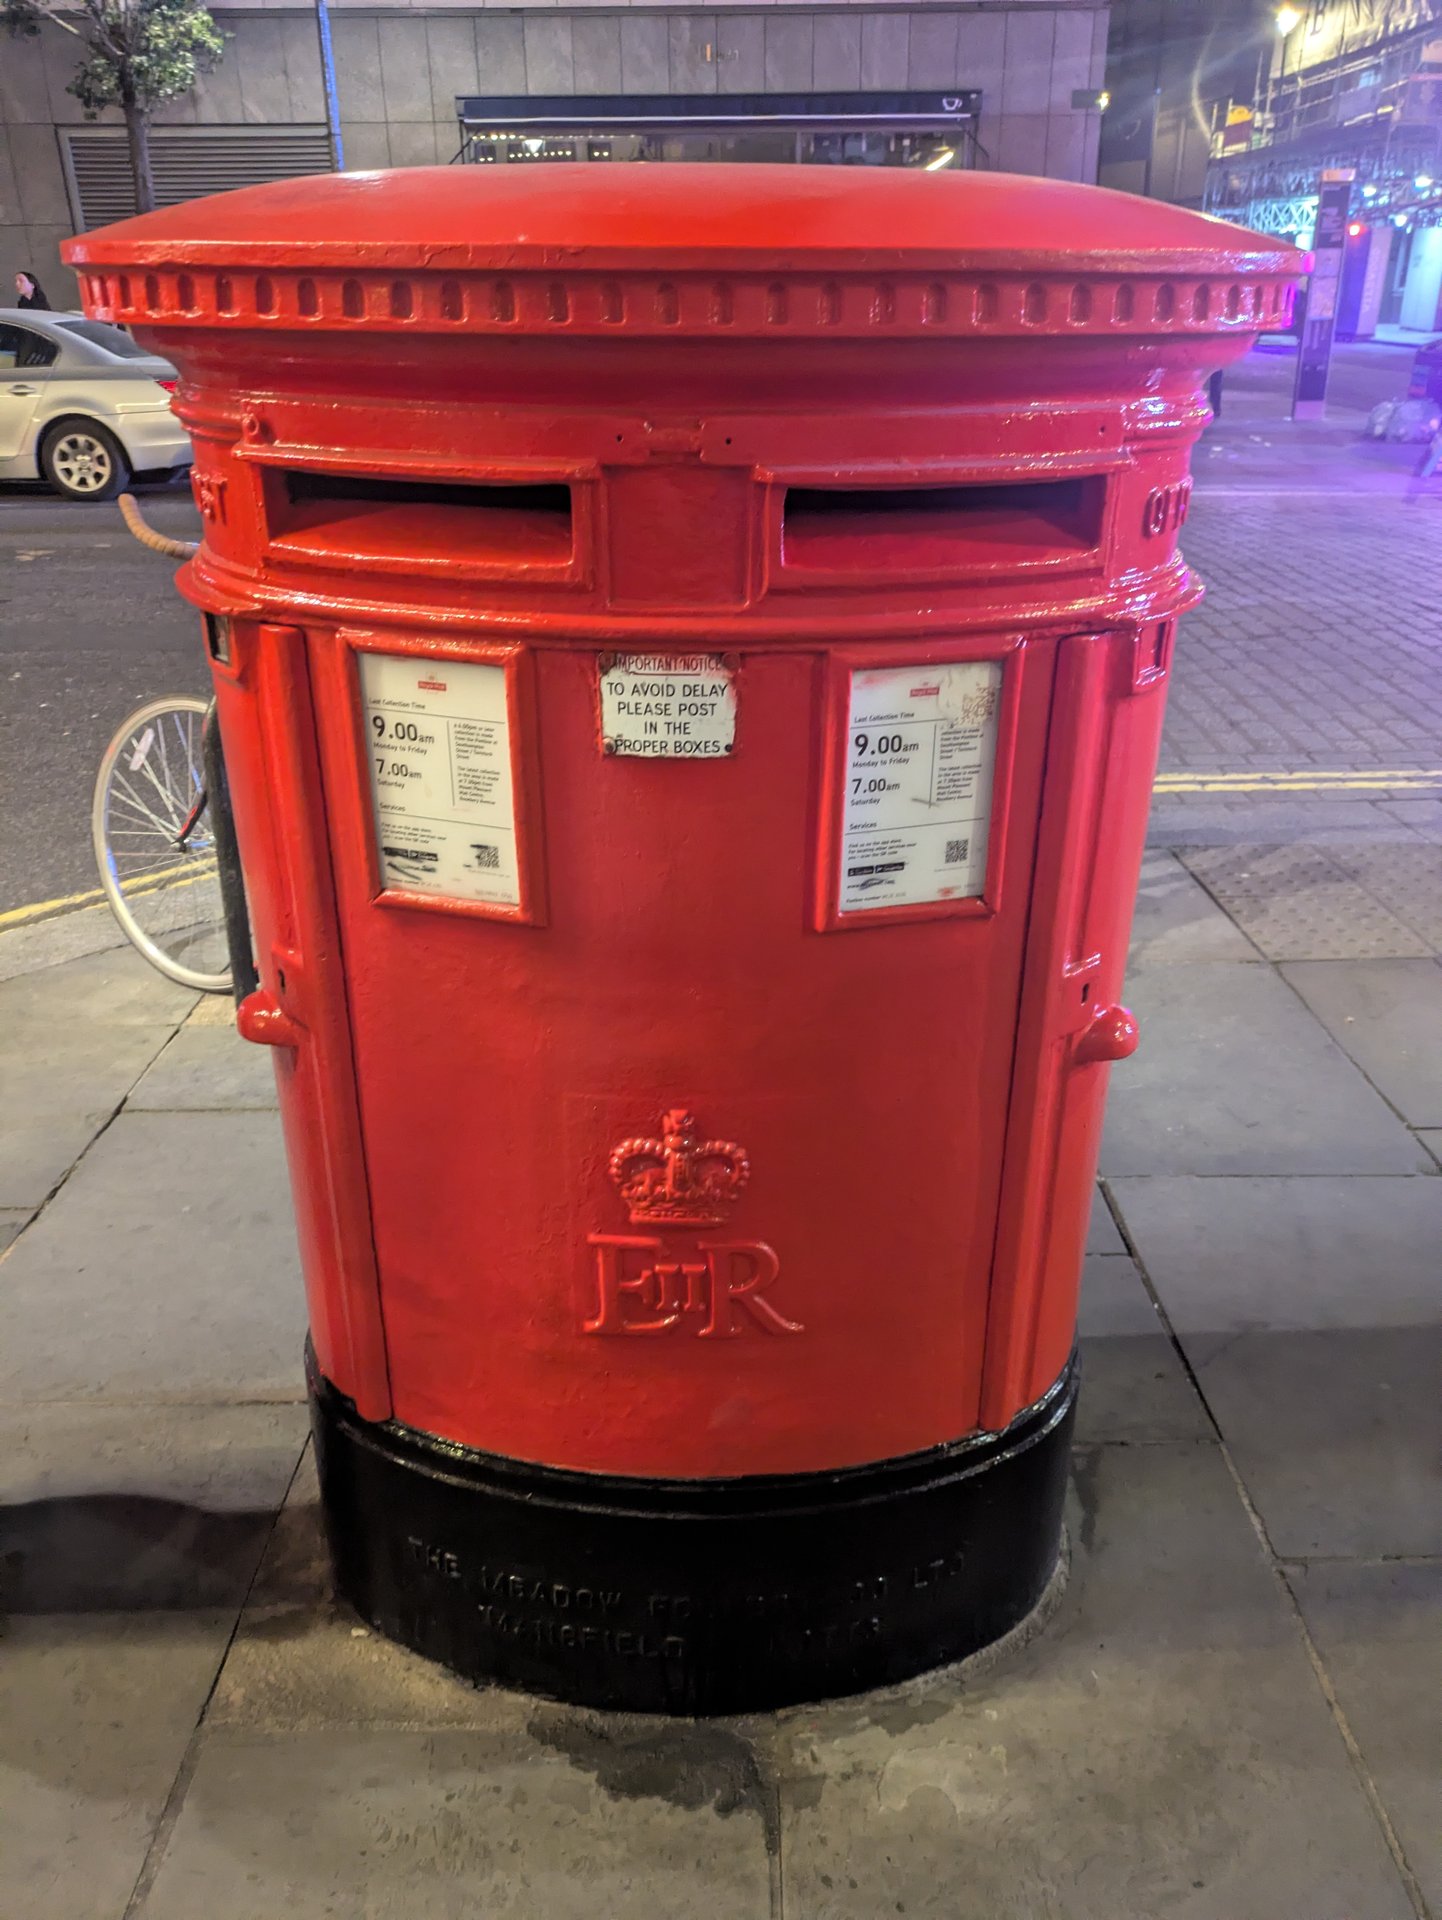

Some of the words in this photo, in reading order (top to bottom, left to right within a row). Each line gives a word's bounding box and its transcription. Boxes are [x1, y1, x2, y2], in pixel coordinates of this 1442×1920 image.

[607, 682, 625, 696] TO
[631, 683, 675, 697] AVOID
[682, 683, 728, 697] DELAY
[618, 702, 671, 715] PLEASE
[679, 703, 717, 716] POST
[372, 715, 435, 744] 9.00am
[645, 722, 657, 735] IN
[664, 722, 691, 735] THE
[616, 739, 668, 753] PROPER
[674, 740, 720, 754] BOXES
[855, 734, 919, 756] 9.00am
[375, 758, 422, 779] 7.00am
[889, 757, 910, 765] Friday
[851, 778, 900, 794] 7.00am
